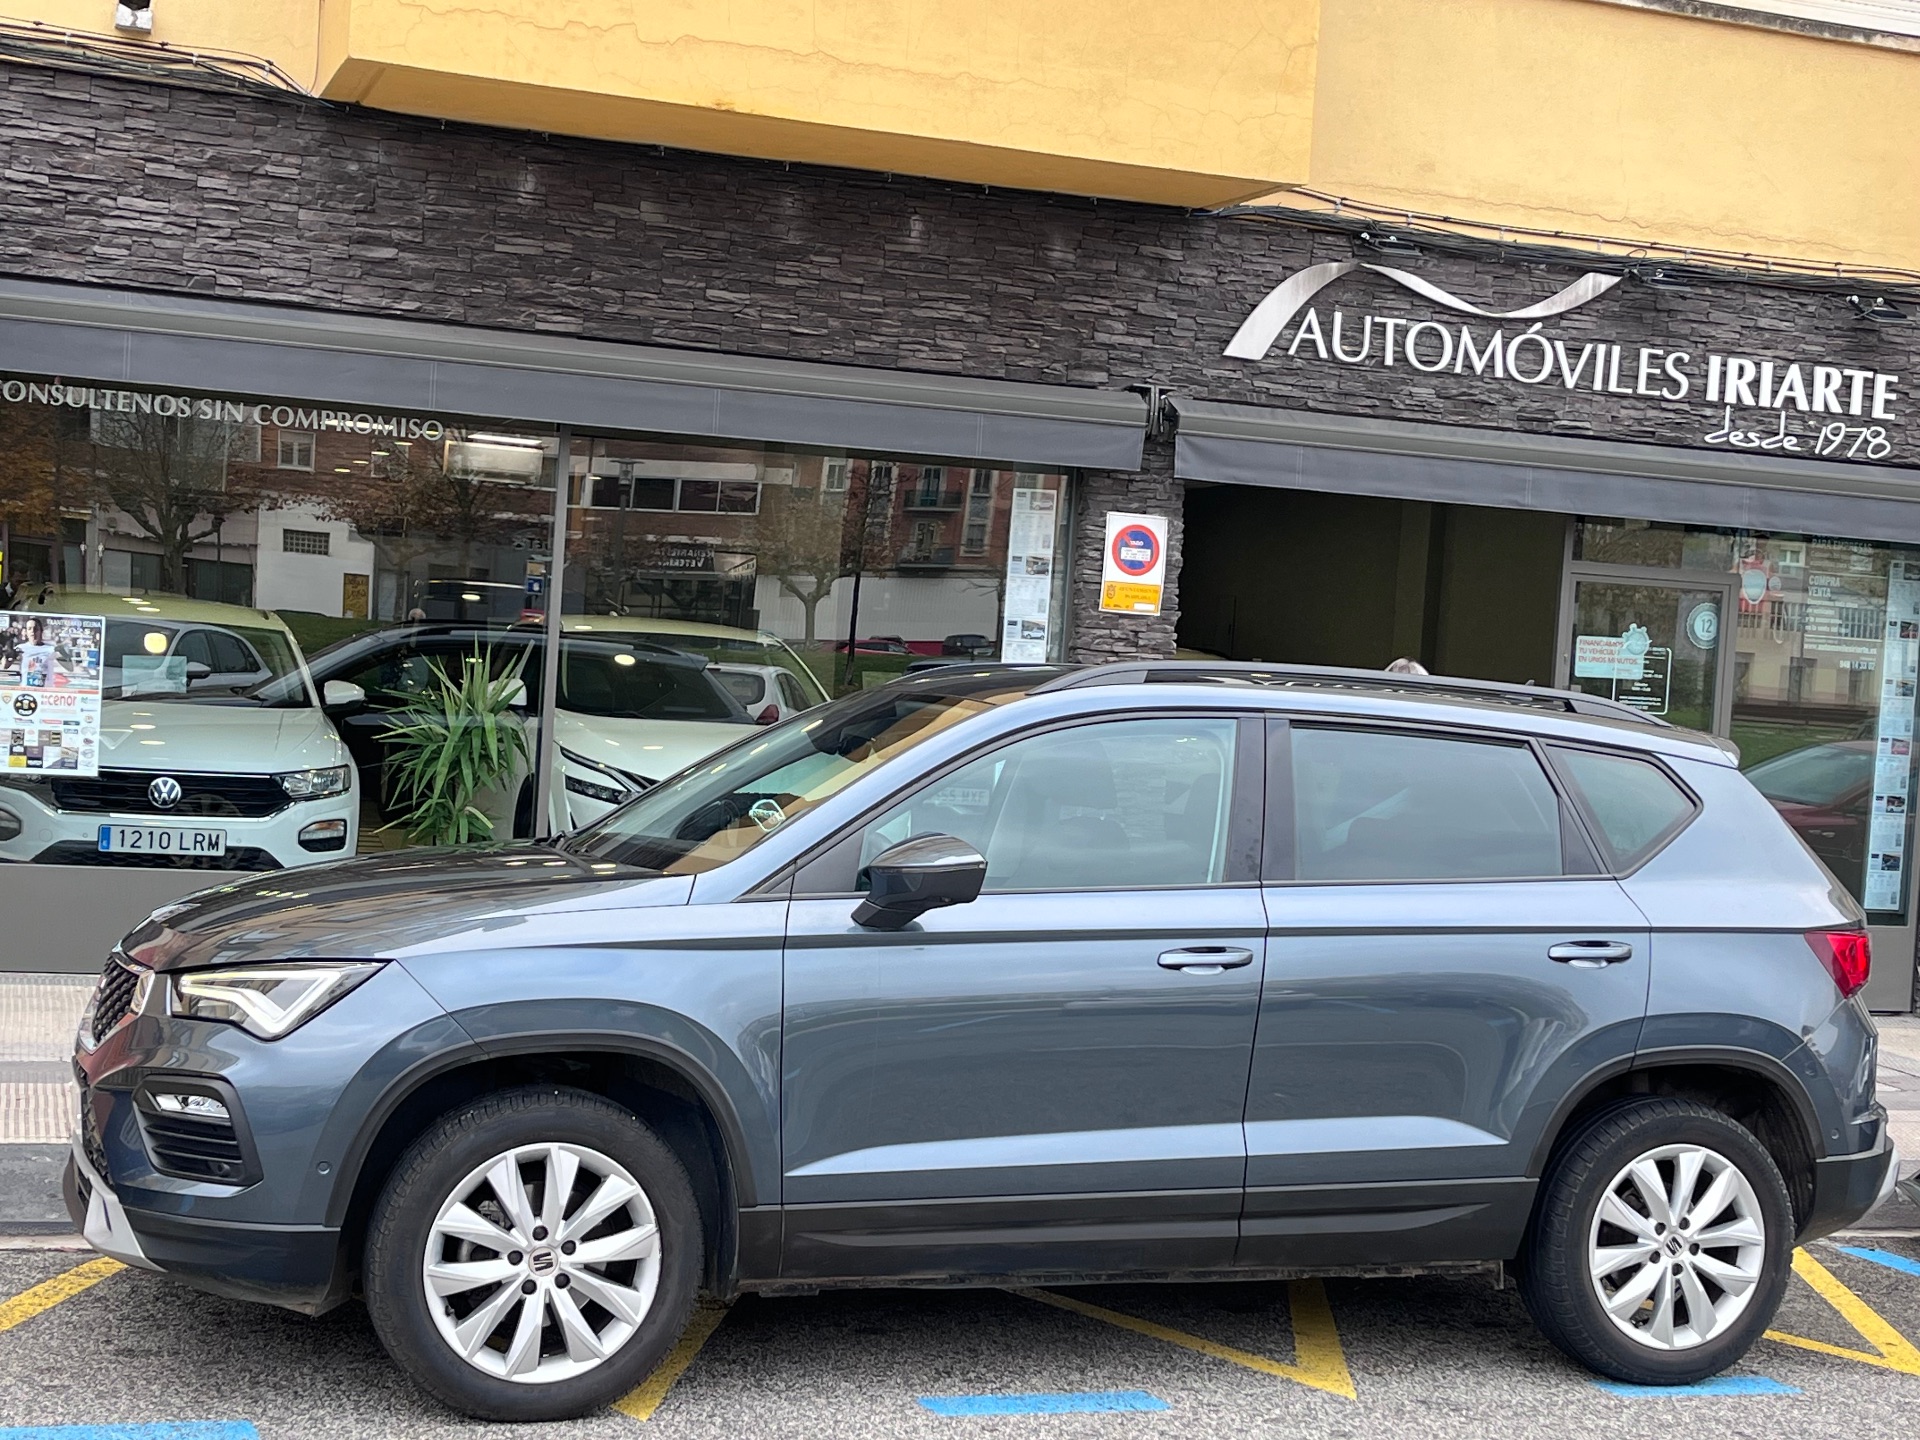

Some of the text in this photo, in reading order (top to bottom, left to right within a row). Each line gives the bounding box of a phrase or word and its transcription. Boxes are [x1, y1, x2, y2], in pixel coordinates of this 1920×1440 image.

[1288, 307, 1900, 421] AUTOMÓVILES IRIARTE
[0, 380, 444, 441] ONSULTENOS SIN COMPROMISO
[1704, 404, 1892, 459] desde 1978
[1809, 575, 1841, 587] COMPRA
[1808, 586, 1832, 598] VENTA
[1701, 618, 1712, 633] 12
[1579, 639, 1624, 648] FINANCIAMOS
[119, 829, 220, 852] 1210 LRM
